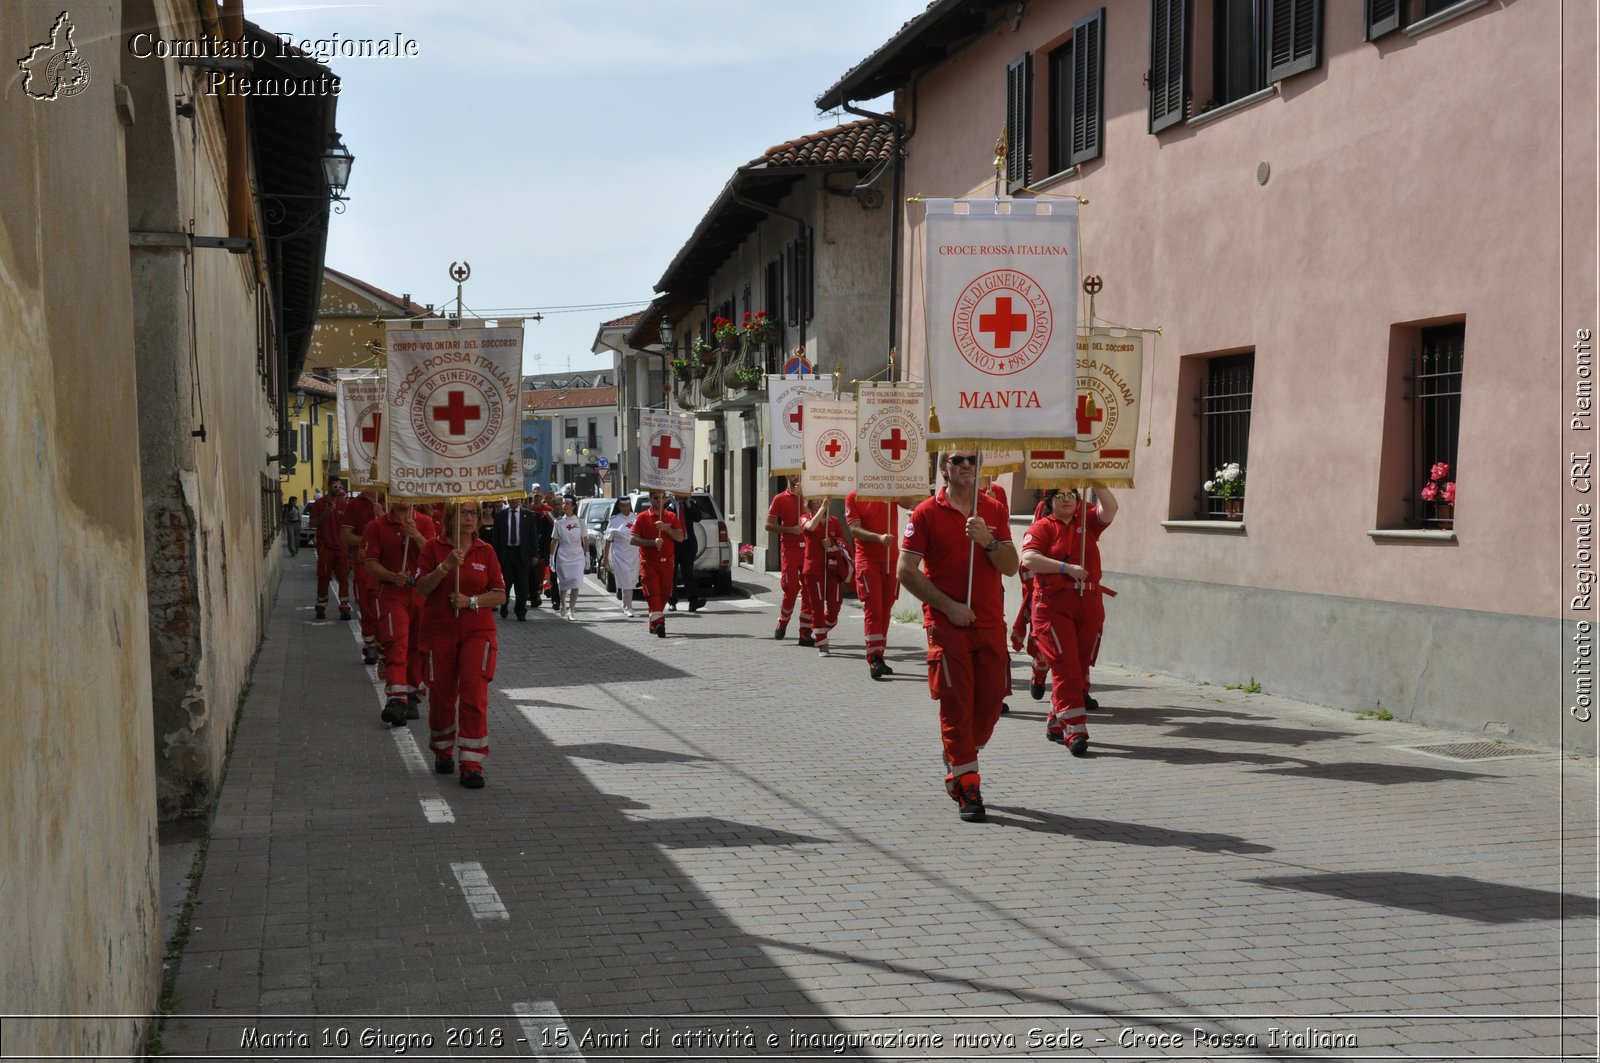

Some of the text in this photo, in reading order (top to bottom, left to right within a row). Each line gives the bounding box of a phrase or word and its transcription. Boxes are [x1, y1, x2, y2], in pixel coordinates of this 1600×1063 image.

[939, 245, 1068, 256] CROCE ROSSA ITALIANA
[957, 273, 1049, 370] CONVENZIONE DI GINEVRA 22 AGOSTO 1864
[393, 338, 517, 352] CORPO VOLONTARI DEL SOCCORSO
[1092, 342, 1104, 351] DEL
[1105, 343, 1135, 352] SOCCORSO
[394, 352, 517, 407] CROCE ROSSA ITALIANA
[1076, 358, 1136, 407] SSA ITALIANA
[1076, 379, 1106, 393] INEVRA
[959, 391, 1042, 409] MANTA
[1105, 394, 1114, 405] 22
[413, 371, 501, 453] CONVENZIONE DI GINEVRA 22 AGOSTO 1864
[859, 414, 878, 440] CROCE
[877, 406, 902, 417] ROSSA
[1105, 406, 1117, 436] AGOSTO
[396, 466, 454, 478] GRUPPO
[459, 466, 473, 477] DI
[1031, 461, 1079, 470] COMITATO
[1082, 461, 1092, 470] DI
[396, 478, 517, 493] COMITATO LOCALE
